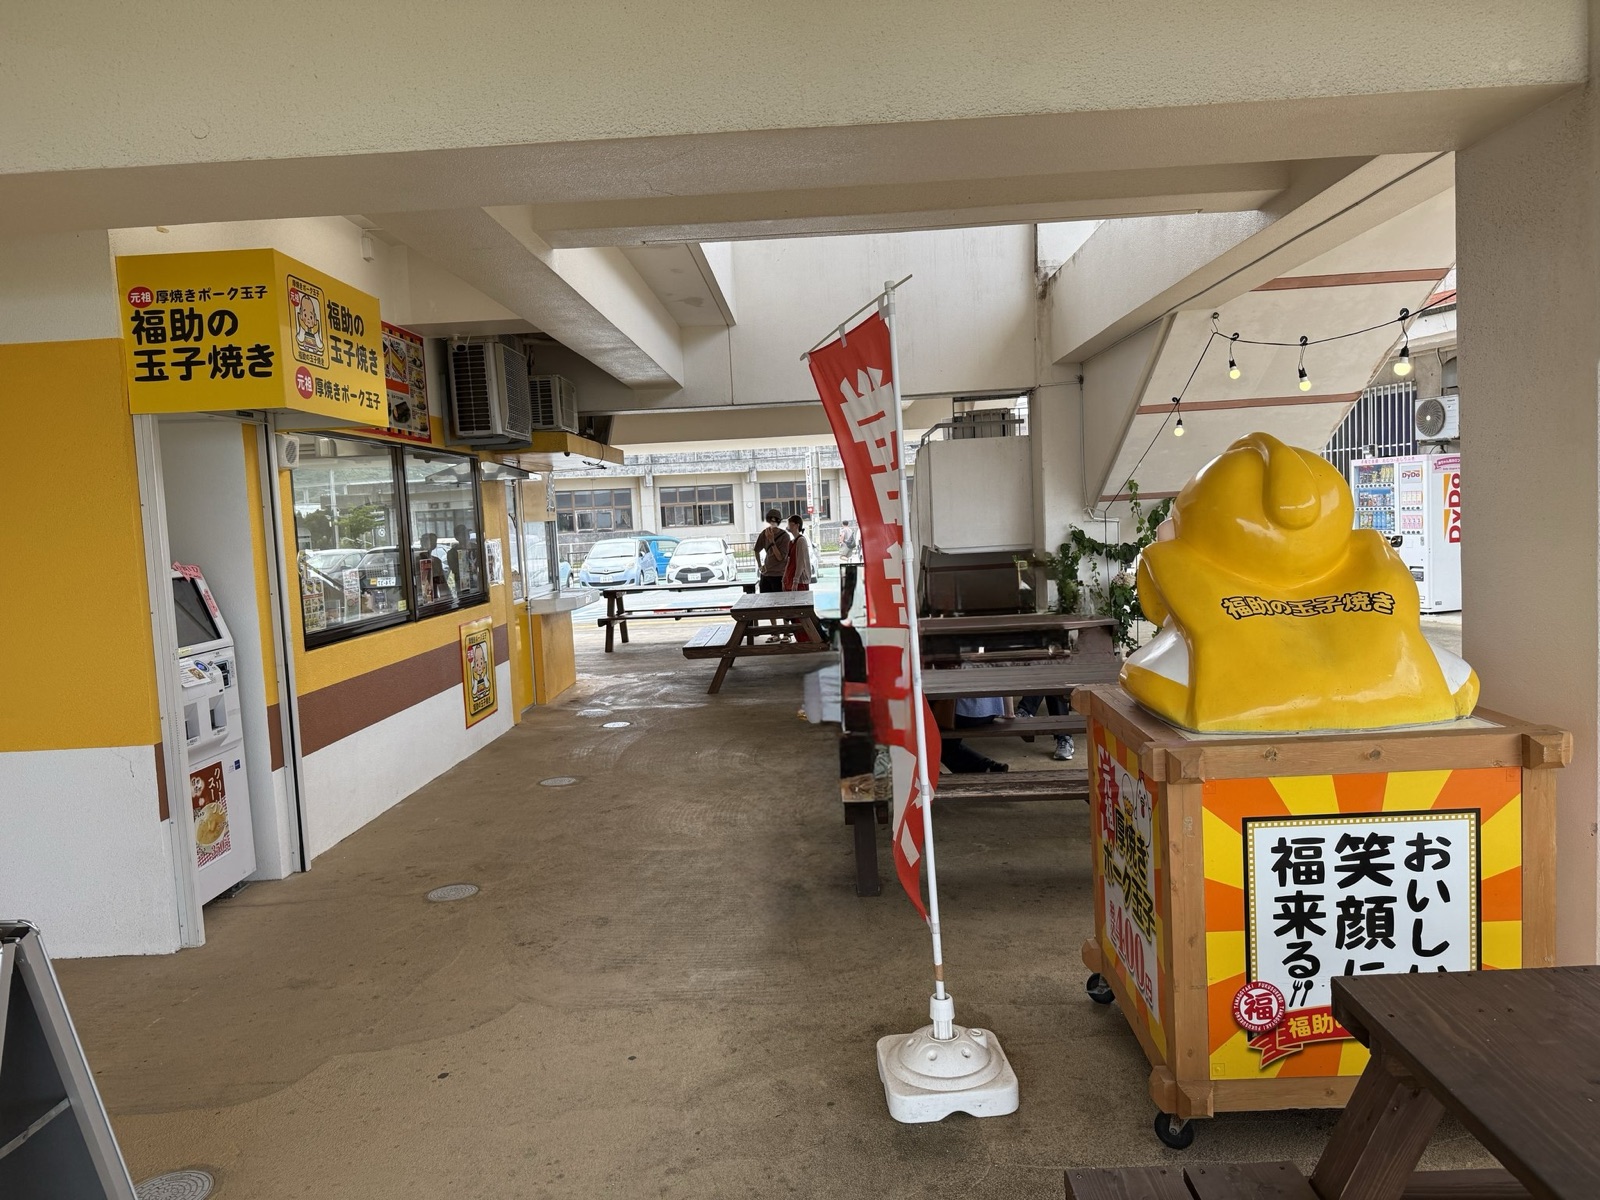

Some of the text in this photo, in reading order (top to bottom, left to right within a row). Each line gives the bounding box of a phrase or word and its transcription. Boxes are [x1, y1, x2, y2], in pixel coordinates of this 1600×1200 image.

[130, 292, 151, 303] 元祖
[156, 285, 268, 304] 厚焼きポーク玉子
[130, 307, 239, 345] 福助の
[326, 299, 364, 336] 福助の
[133, 344, 275, 382] 玉子焼き
[330, 335, 378, 376] 玉子焼き
[297, 373, 313, 392] 元祖
[315, 377, 381, 410] 厚焼きポーク玉子
[1402, 471, 1420, 479] DyDo
[1220, 591, 1396, 620] 福助の玉子焼き
[1102, 763, 1115, 831] 元祖
[1115, 806, 1148, 884] 厚焼き
[1103, 841, 1157, 942] ポーク玉子
[1244, 992, 1273, 1020] 福
[1287, 1012, 1342, 1039] 福助
